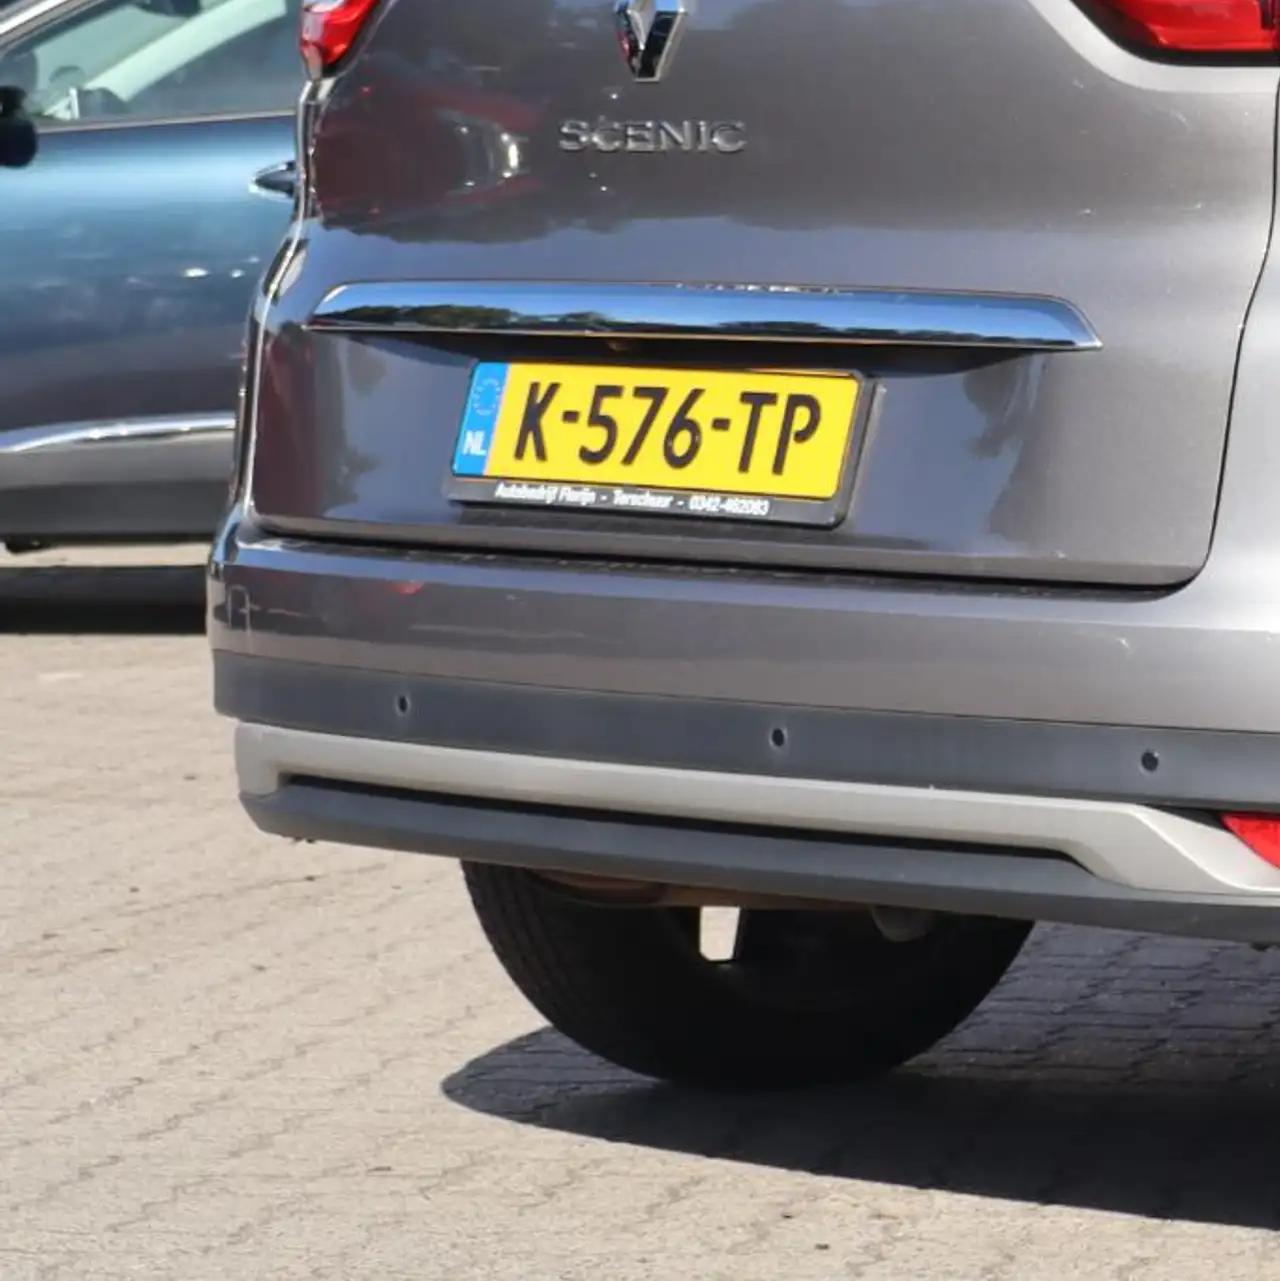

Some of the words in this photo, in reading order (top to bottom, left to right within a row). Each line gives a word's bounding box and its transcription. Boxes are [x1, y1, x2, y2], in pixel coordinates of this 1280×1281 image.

[558, 119, 748, 153] SCENIC
[462, 430, 488, 457] NL
[513, 381, 822, 476] K-576-TP
